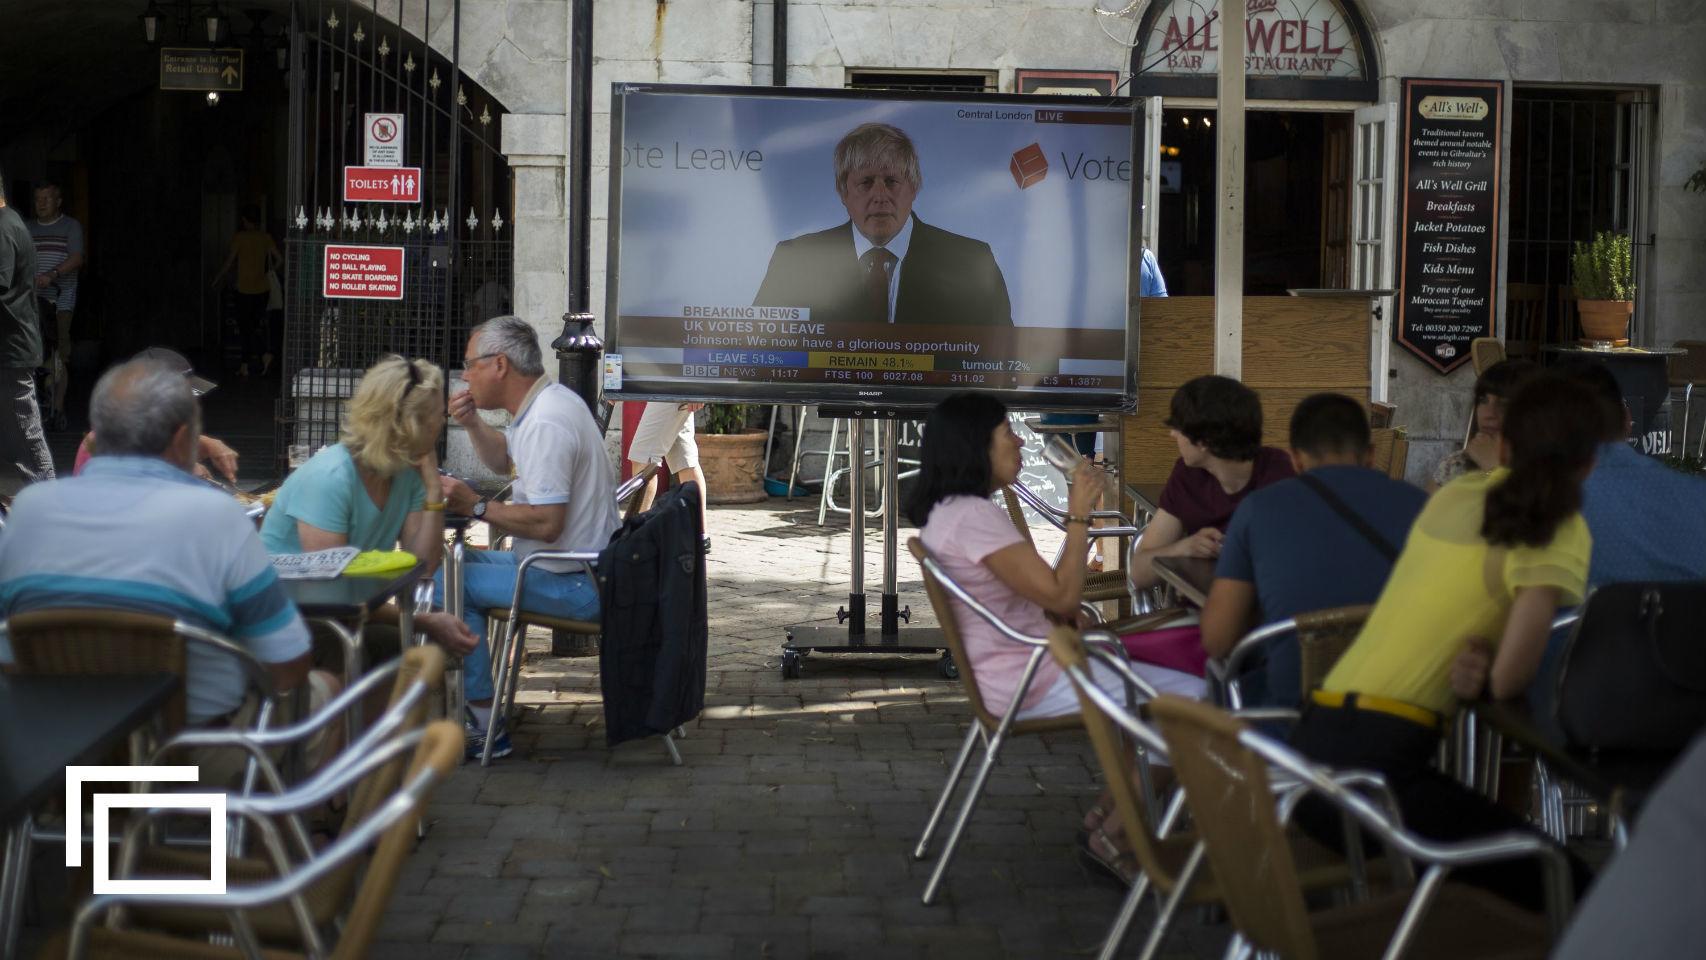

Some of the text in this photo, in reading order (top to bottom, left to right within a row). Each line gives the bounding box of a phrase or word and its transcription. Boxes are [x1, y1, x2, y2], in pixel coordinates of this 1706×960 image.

[1167, 55, 1336, 71] BAR STAURANT
[1429, 101, 1479, 113] All's Well
[957, 109, 1065, 121] Central London LIVE
[1422, 128, 1484, 138] Traditional tavern
[1413, 138, 1492, 148] themed around notable
[675, 141, 764, 171] Leave
[1440, 149, 1448, 157] in
[1449, 149, 1487, 158] Gibraltar's
[1061, 152, 1131, 181] Vote
[1447, 160, 1472, 170] history
[349, 179, 389, 190] TOILETS
[1416, 179, 1488, 191] All's Well Grill
[1426, 200, 1476, 214] Breakfasts
[1414, 221, 1486, 233] Jacket Potatoes
[1422, 242, 1476, 254] Fish Dishes
[341, 263, 358, 271] BALL
[1422, 263, 1475, 275] Kids Menu
[341, 273, 363, 281] SKATE
[1421, 284, 1435, 295] Try
[1451, 285, 1462, 296] of
[1411, 296, 1484, 308] Moroccan Tagines!
[683, 306, 800, 320] BREAKING NEWS
[684, 320, 825, 335] UK VOTES TO LEAVE
[1411, 323, 1424, 331] Tel:
[683, 333, 980, 355] Johnson: We now have a glorious opportunity
[708, 352, 784, 365] LEAVE 51.9%
[828, 356, 914, 369] REMAIN 48.1%
[961, 359, 1031, 372] turnout 72%
[724, 367, 757, 378] NEWS
[771, 369, 799, 378] 11:17
[824, 370, 924, 382] FTSE 100 6027.08
[951, 374, 985, 383] 311.02
